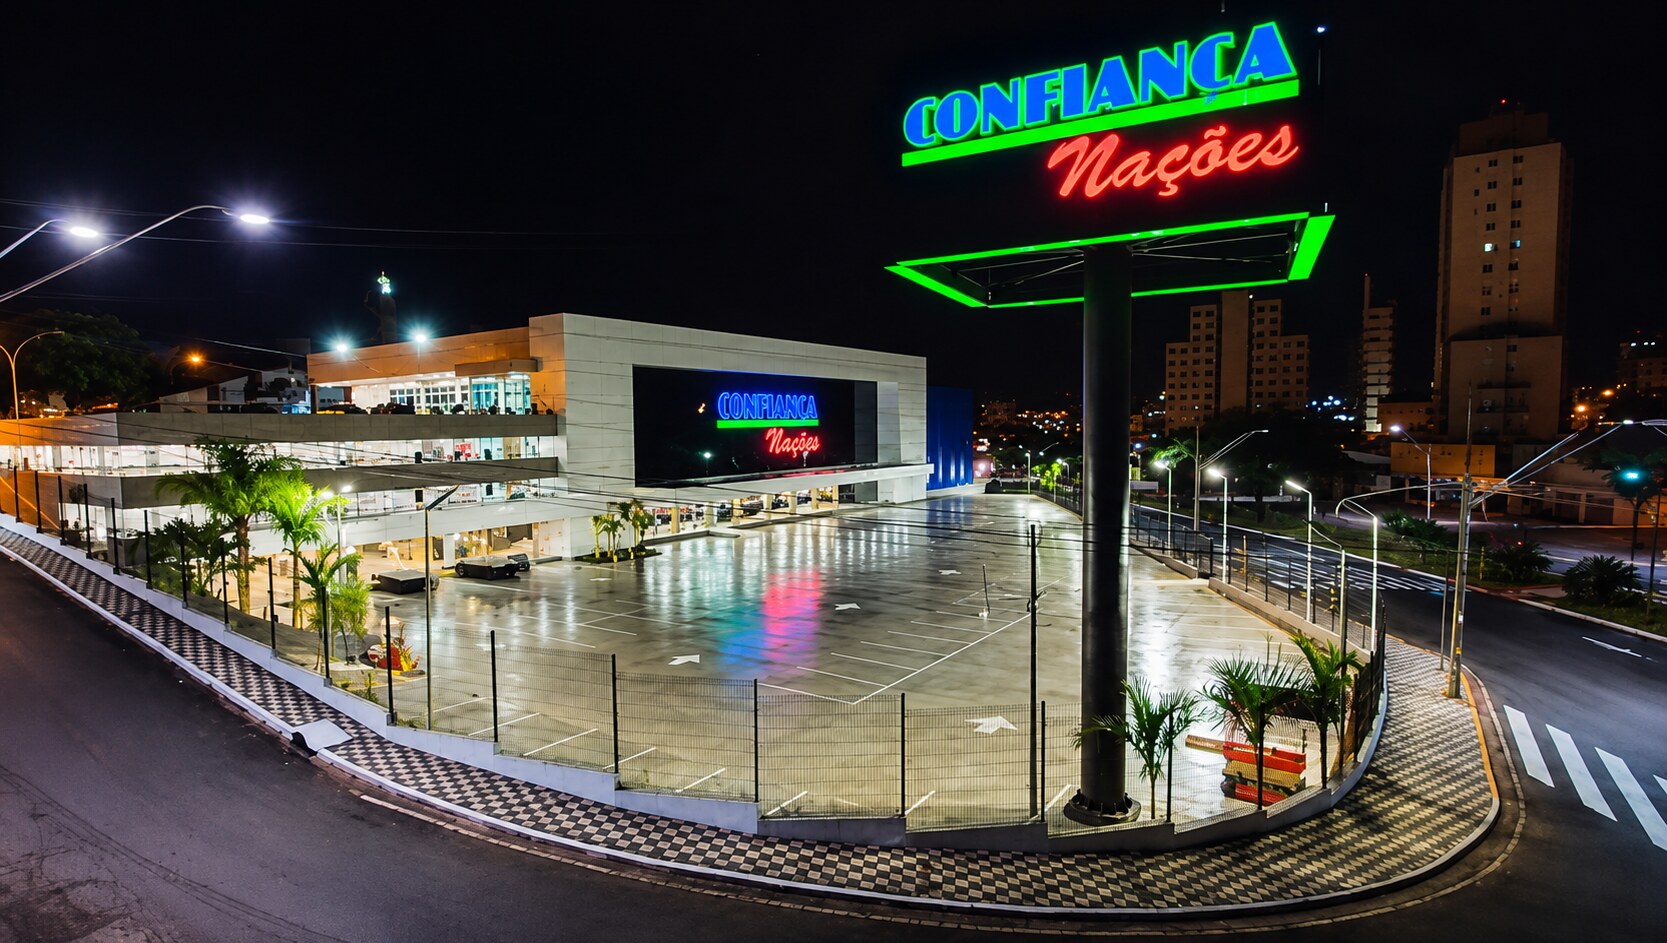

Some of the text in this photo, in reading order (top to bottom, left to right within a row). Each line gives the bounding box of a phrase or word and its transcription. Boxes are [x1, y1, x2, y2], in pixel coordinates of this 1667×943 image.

[903, 22, 1298, 148] CONFIANÇA
[1047, 126, 1299, 197] Nações
[718, 392, 818, 420] CONFIANÇA
[765, 428, 820, 458] Nações
